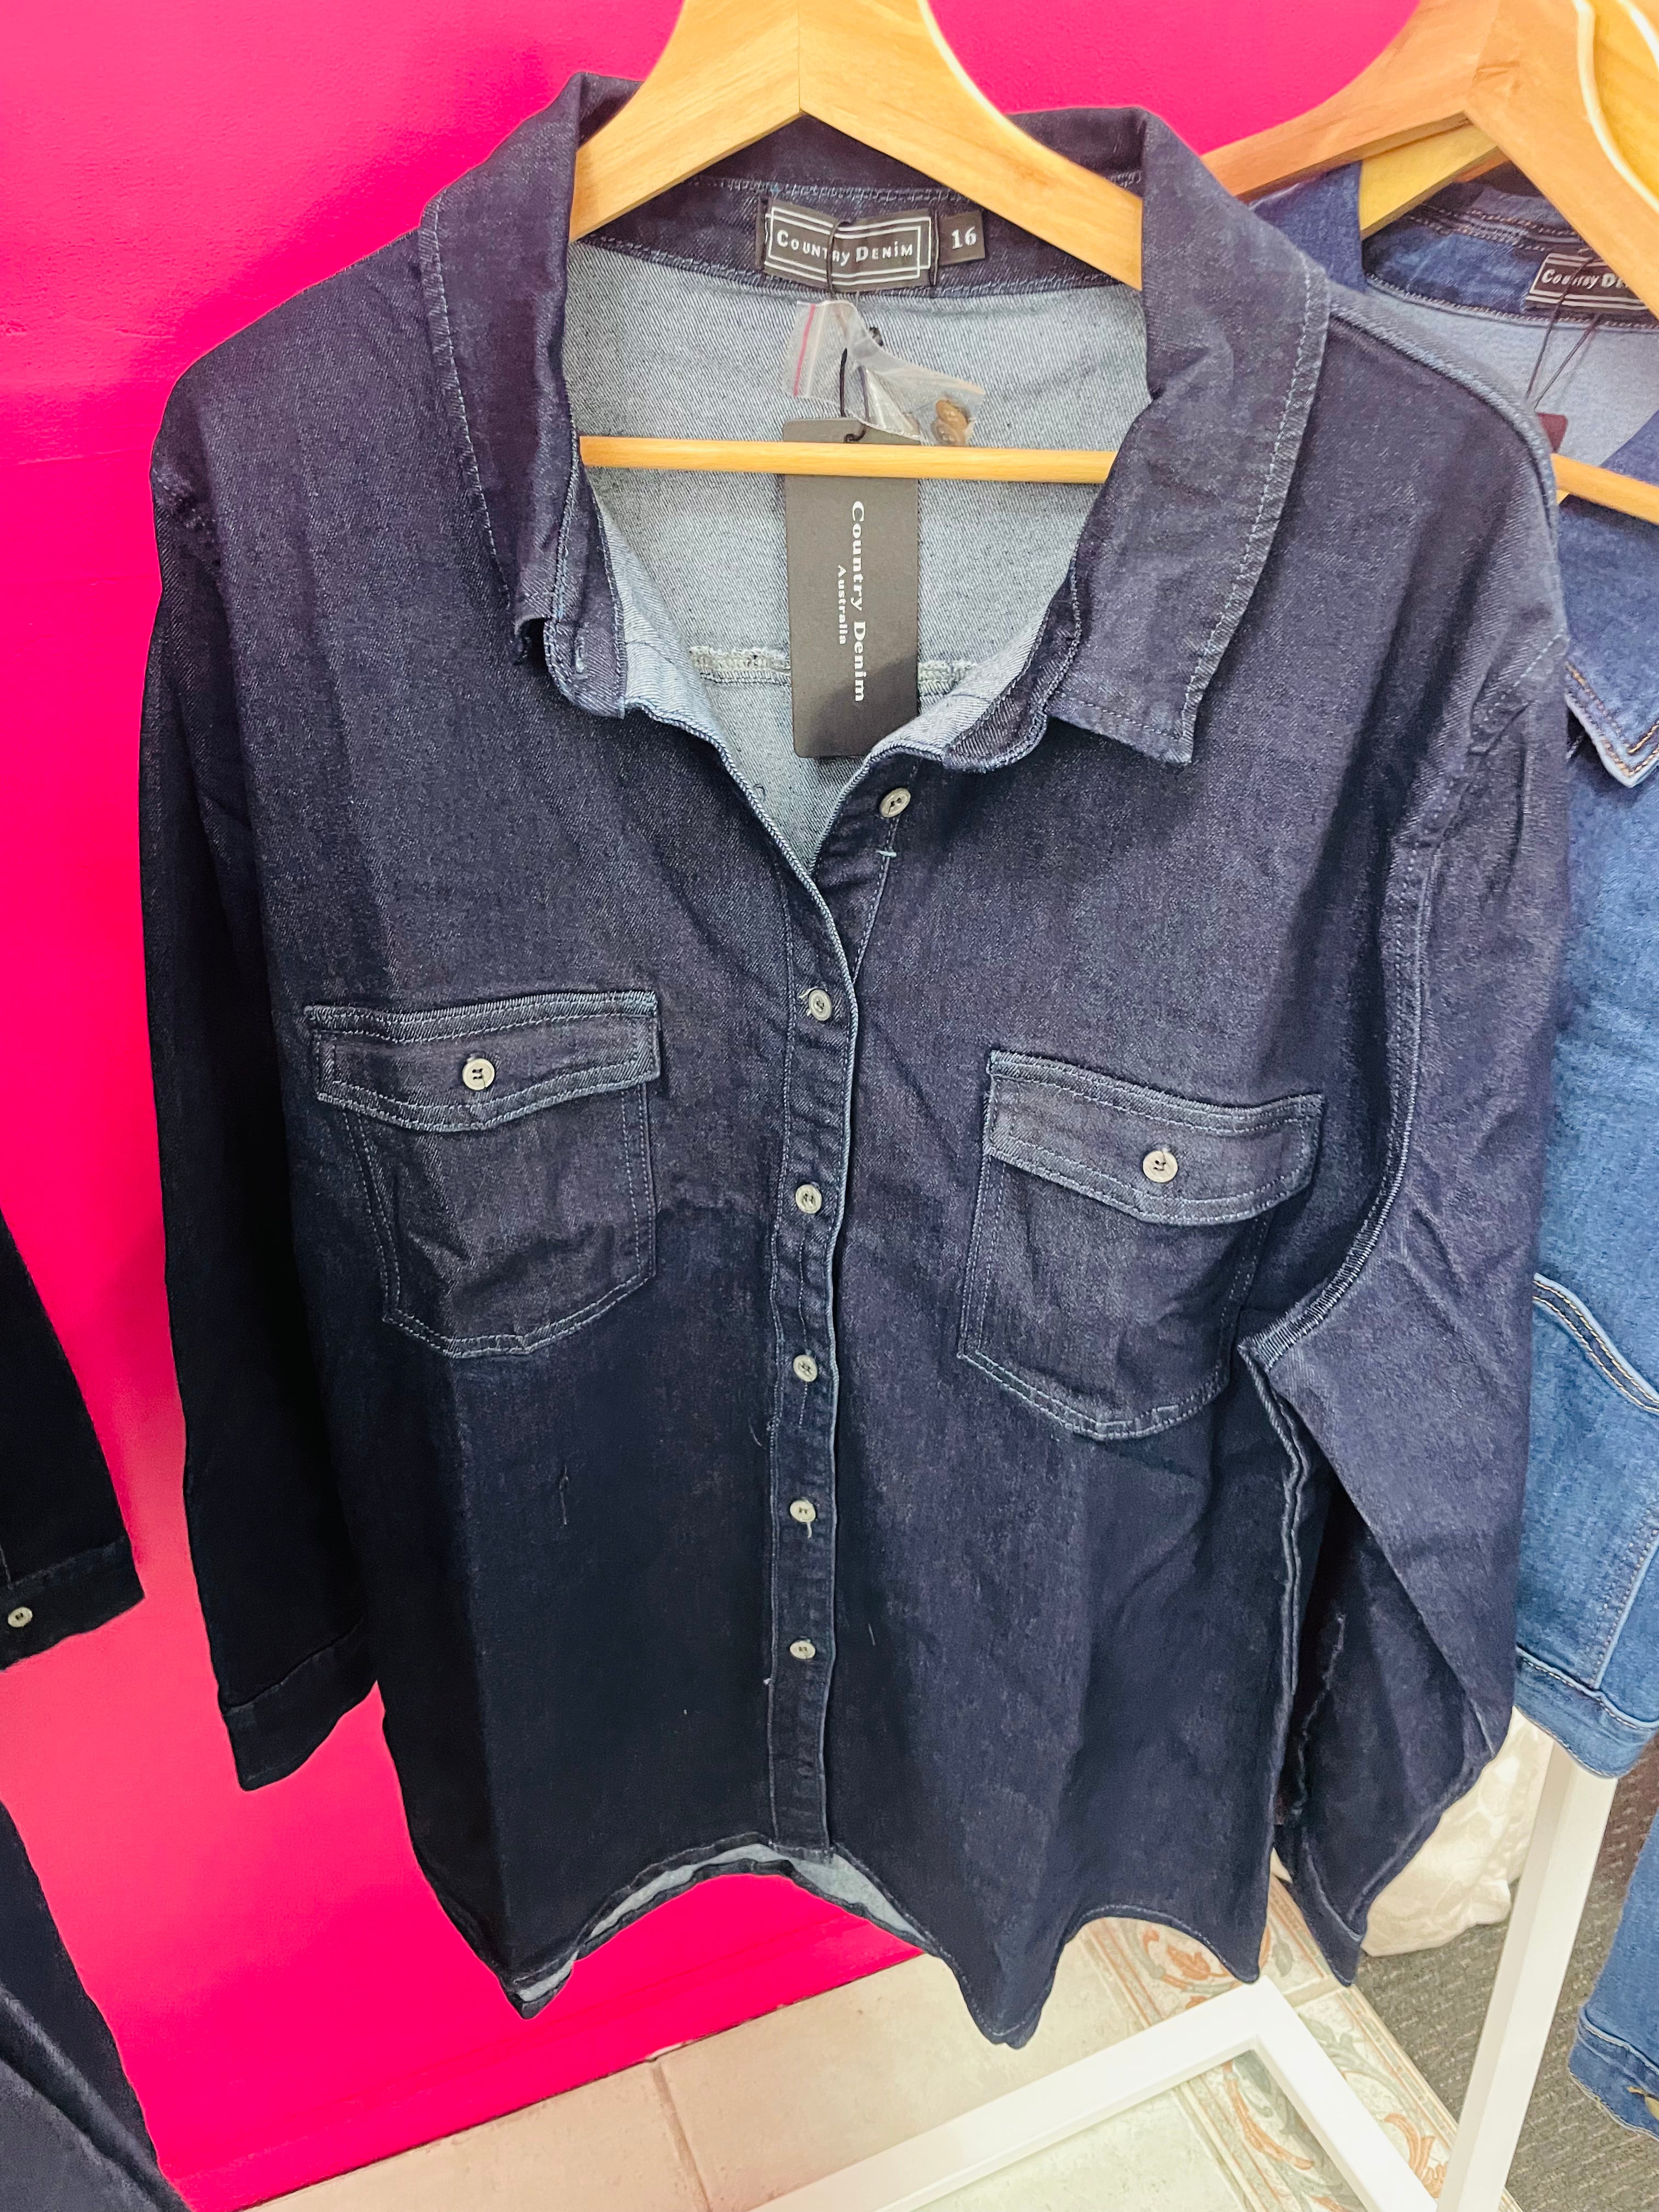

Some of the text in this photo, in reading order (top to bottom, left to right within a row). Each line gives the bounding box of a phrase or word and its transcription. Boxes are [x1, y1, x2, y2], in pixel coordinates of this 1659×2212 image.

[951, 226, 977, 249] 16
[838, 565, 848, 644] Australia
[851, 501, 867, 702] Country Denim
